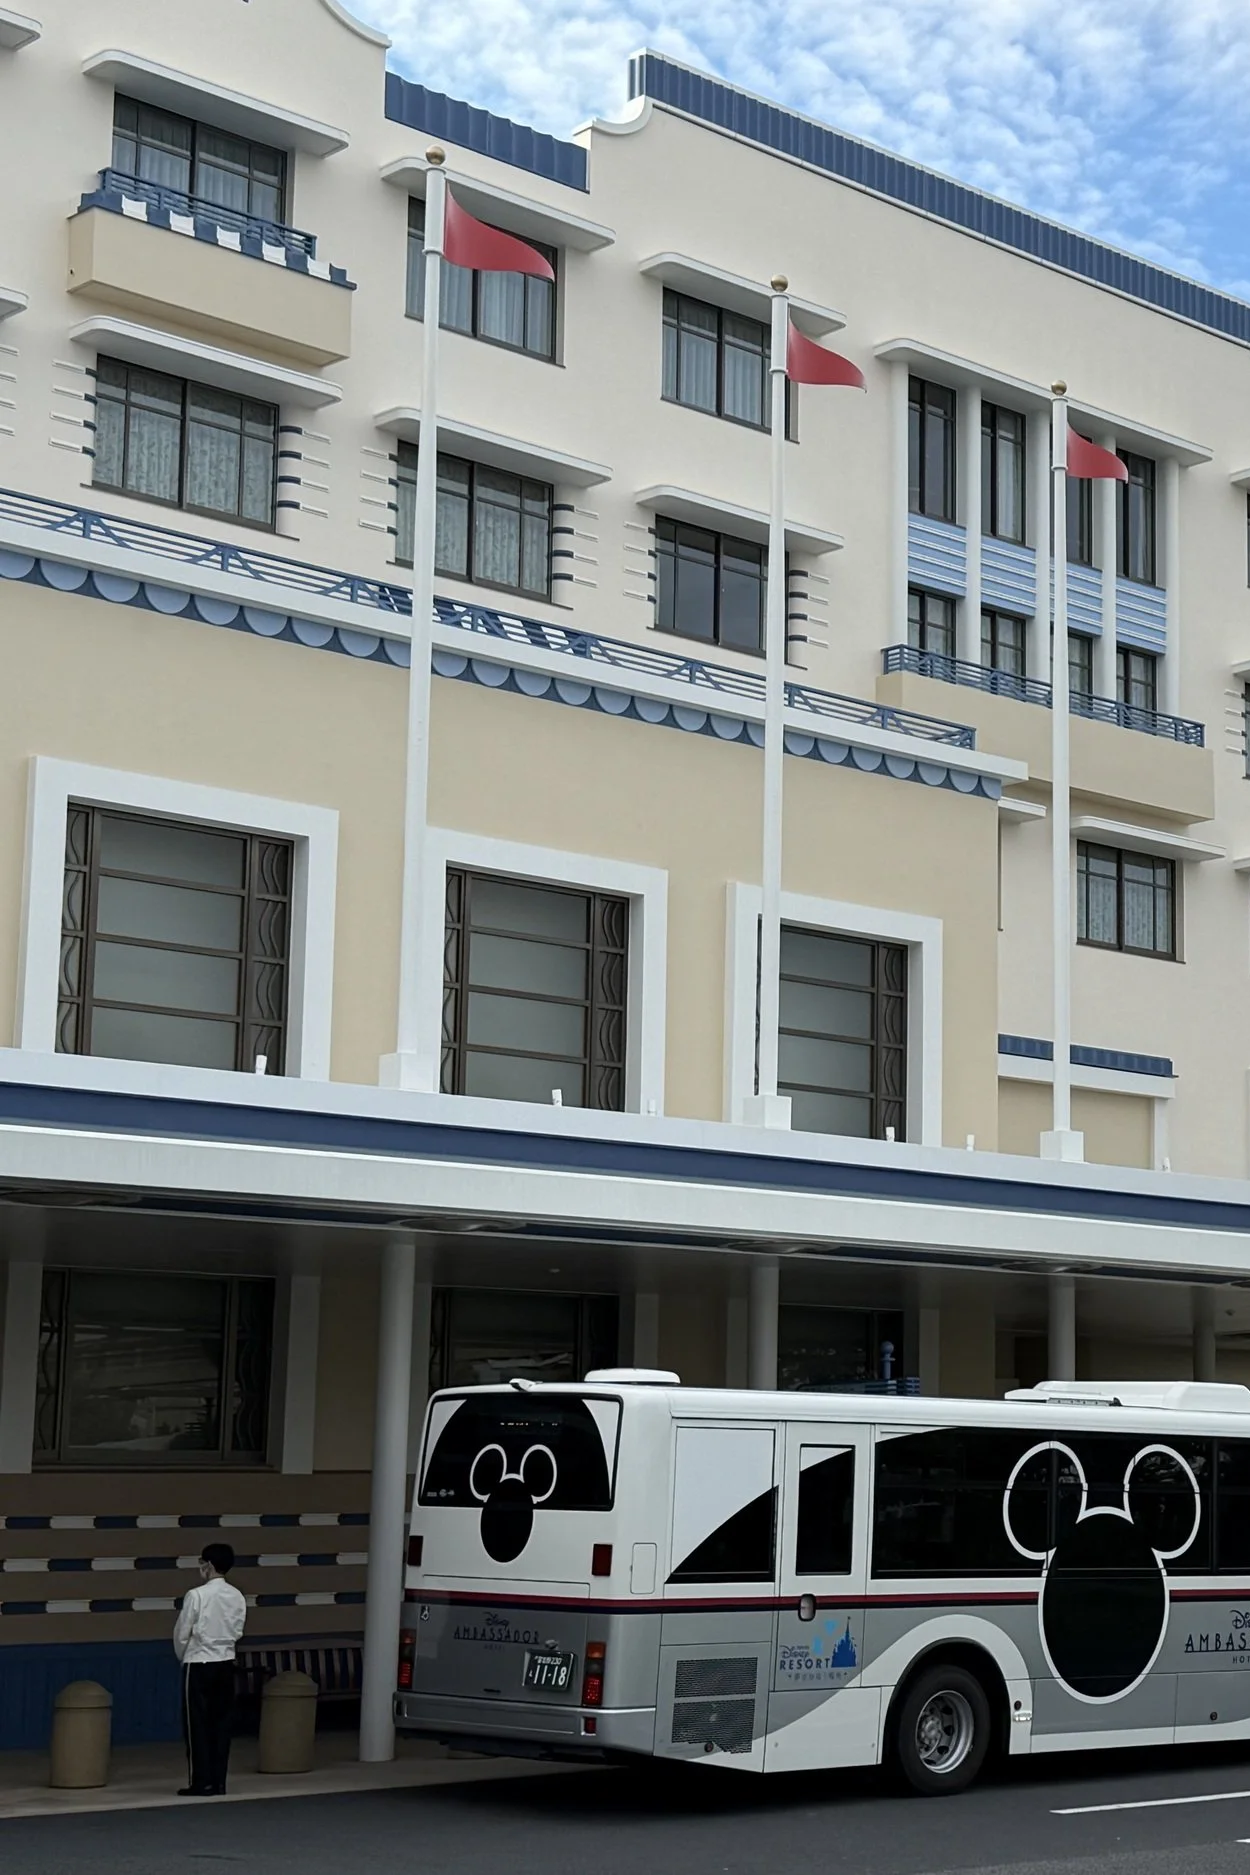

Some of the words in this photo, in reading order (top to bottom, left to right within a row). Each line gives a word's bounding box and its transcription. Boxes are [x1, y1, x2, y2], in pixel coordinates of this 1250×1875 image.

[453, 1625, 540, 1645] AMBASSADOR
[780, 1658, 830, 1670] RESORT
[533, 1664, 567, 1686] 11-18
